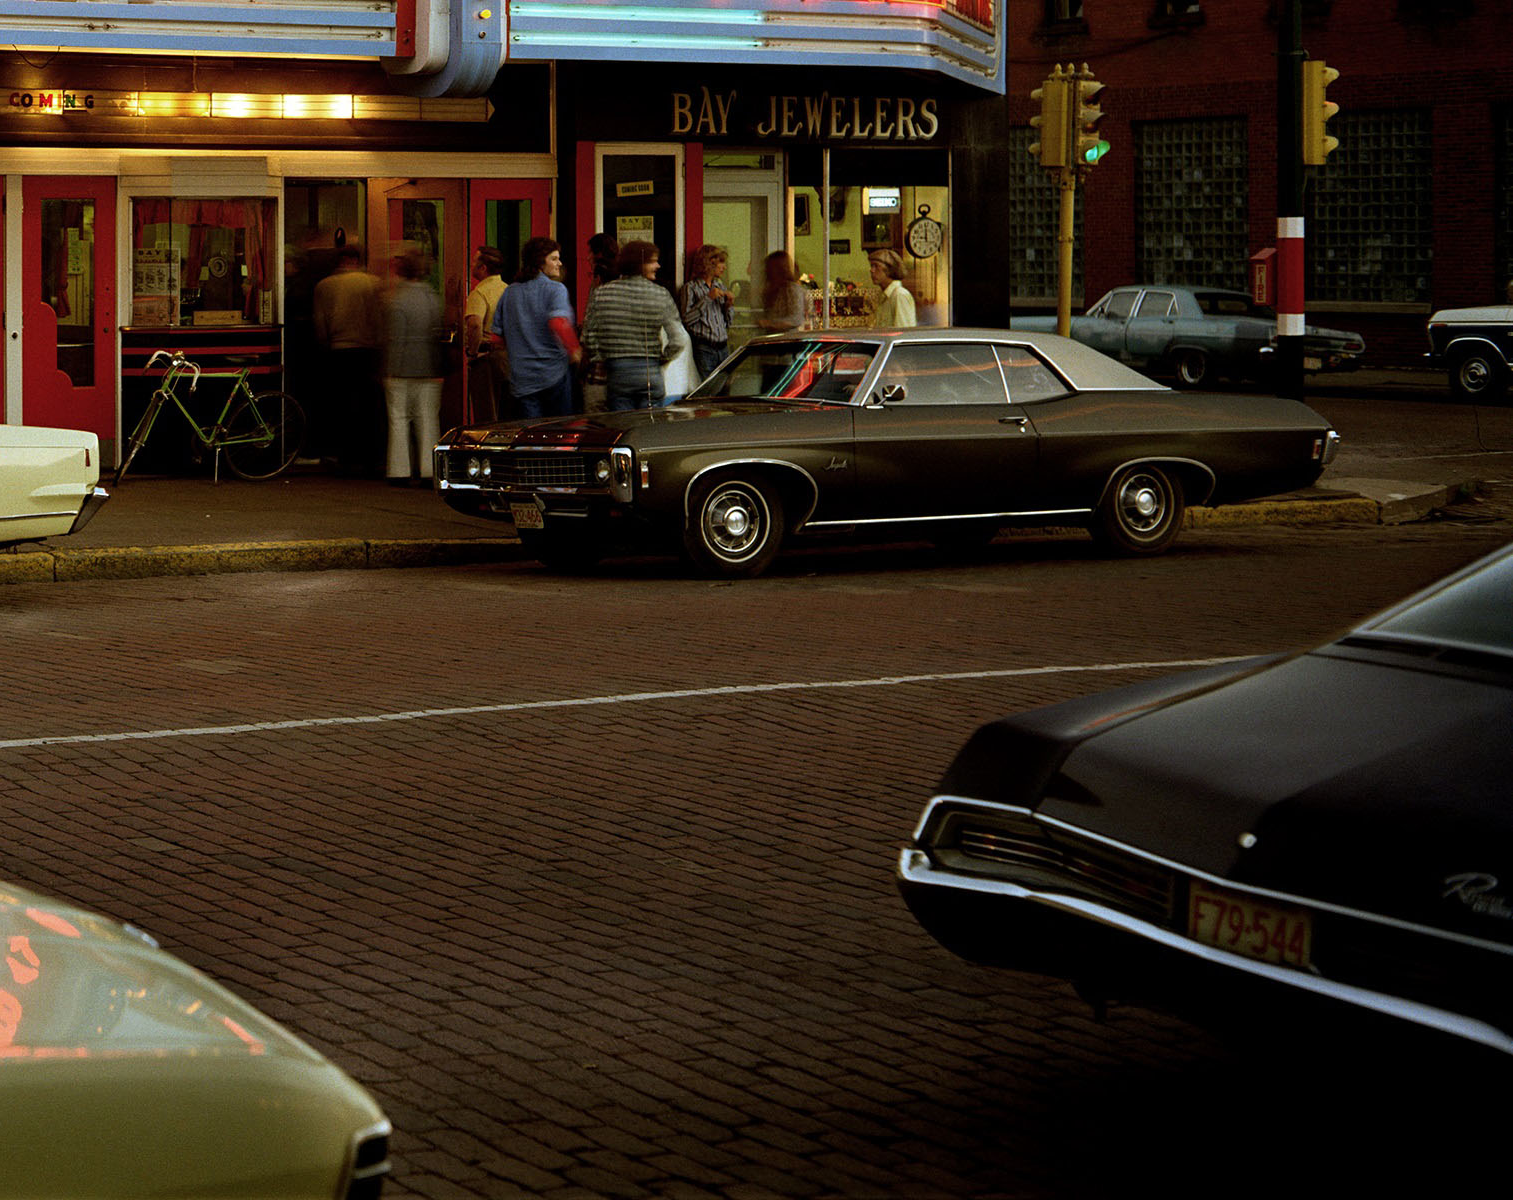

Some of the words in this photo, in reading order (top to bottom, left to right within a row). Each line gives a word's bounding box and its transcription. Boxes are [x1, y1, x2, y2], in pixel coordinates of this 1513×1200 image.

[9, 92, 94, 109] COMING
[672, 86, 737, 135] BAY
[757, 91, 939, 141] JEWELERS
